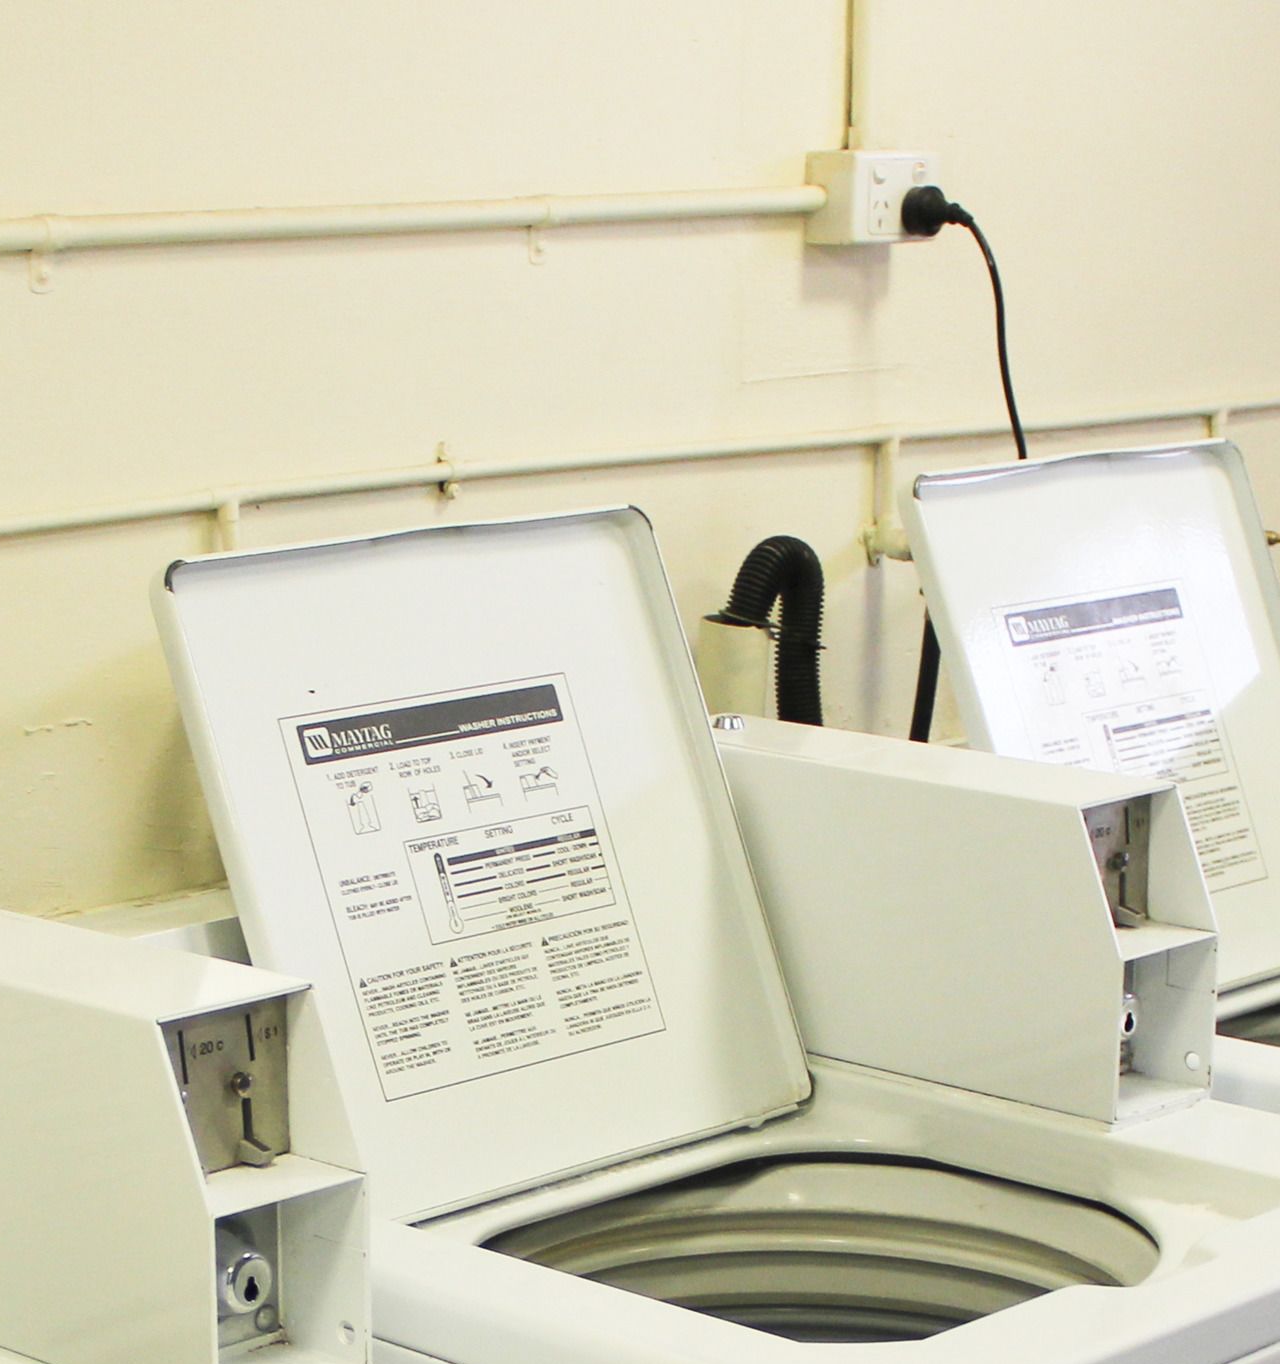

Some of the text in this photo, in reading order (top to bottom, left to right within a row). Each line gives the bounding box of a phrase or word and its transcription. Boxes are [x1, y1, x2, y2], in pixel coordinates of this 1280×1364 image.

[457, 708, 558, 733] WASHER INSTRUCTIONS
[329, 722, 392, 748] MAYTAG
[333, 739, 393, 754] COMMERCIAL
[550, 813, 574, 825] CYCLE
[483, 825, 514, 839] SETTING
[408, 835, 459, 853] TEMPERATURE
